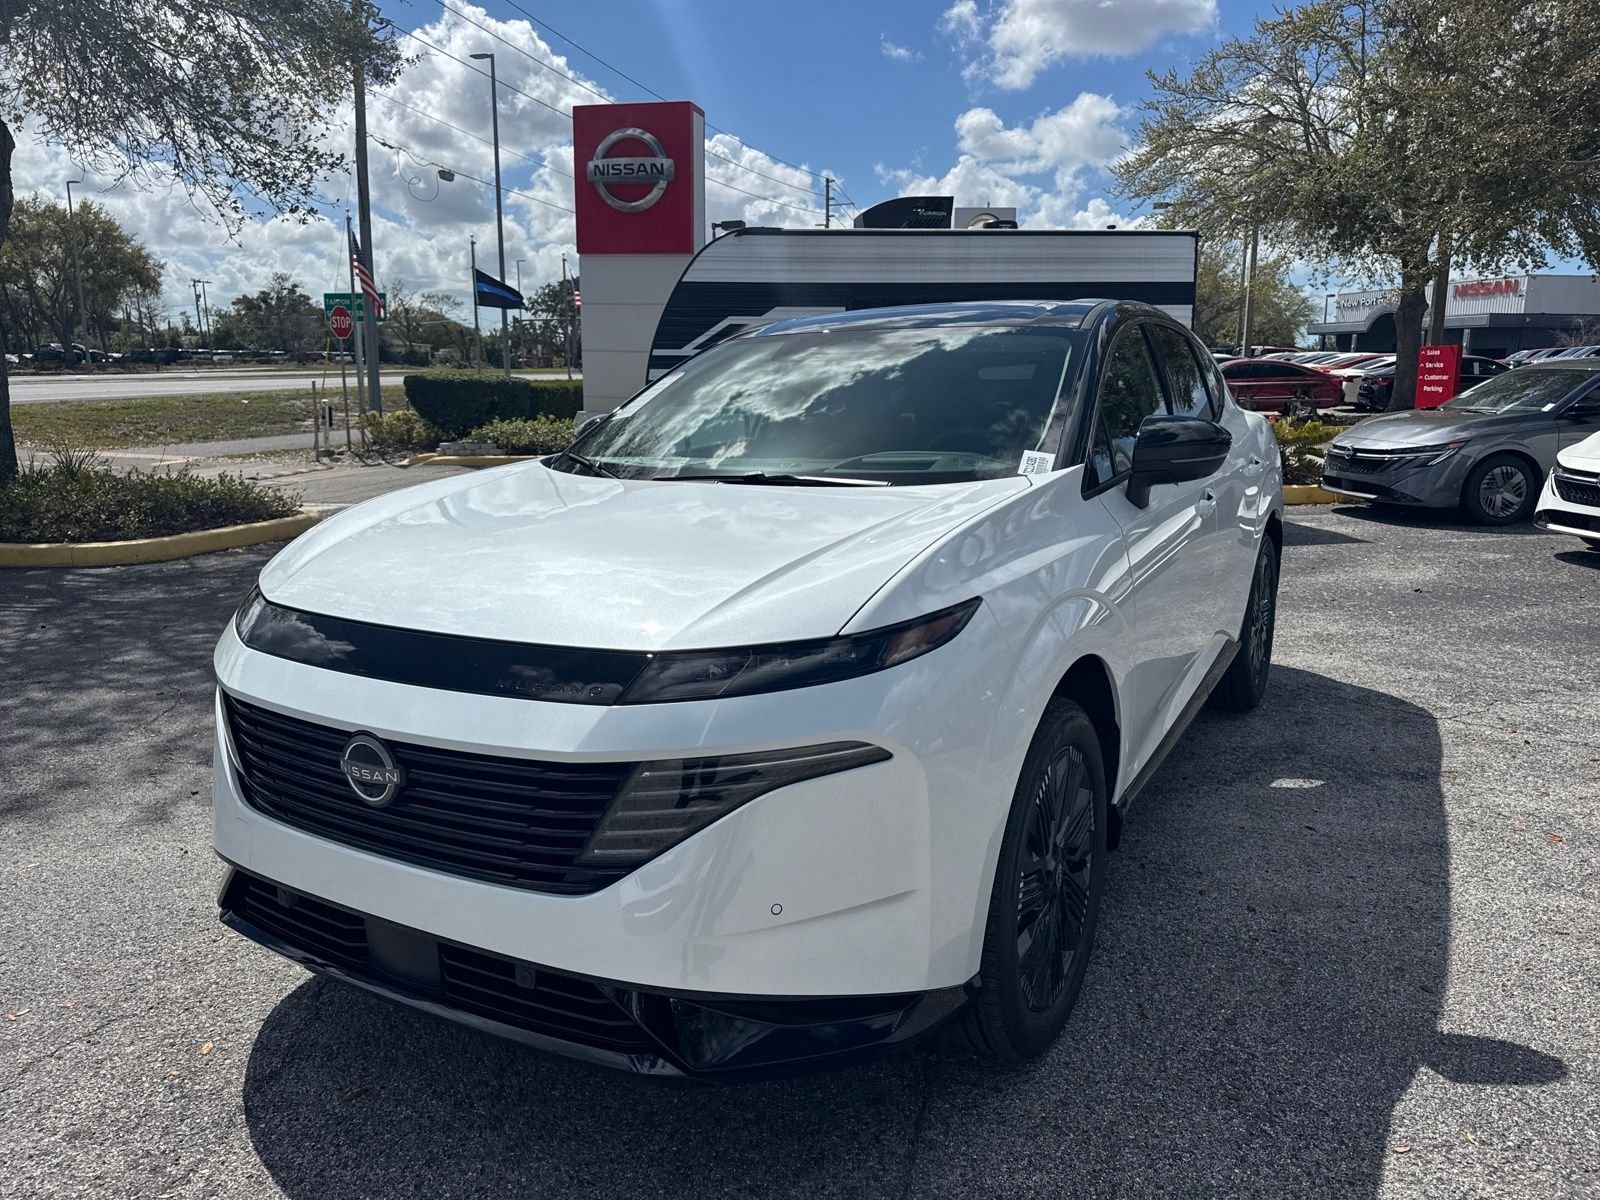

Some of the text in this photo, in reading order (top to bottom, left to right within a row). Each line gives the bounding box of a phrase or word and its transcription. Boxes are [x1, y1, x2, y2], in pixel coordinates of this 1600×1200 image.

[594, 163, 664, 176] NISSAN
[1455, 281, 1518, 298] NISSAN
[1342, 299, 1358, 308] New
[1361, 297, 1376, 306] Port
[332, 317, 350, 328] STOP
[341, 760, 397, 782] NISSAN
